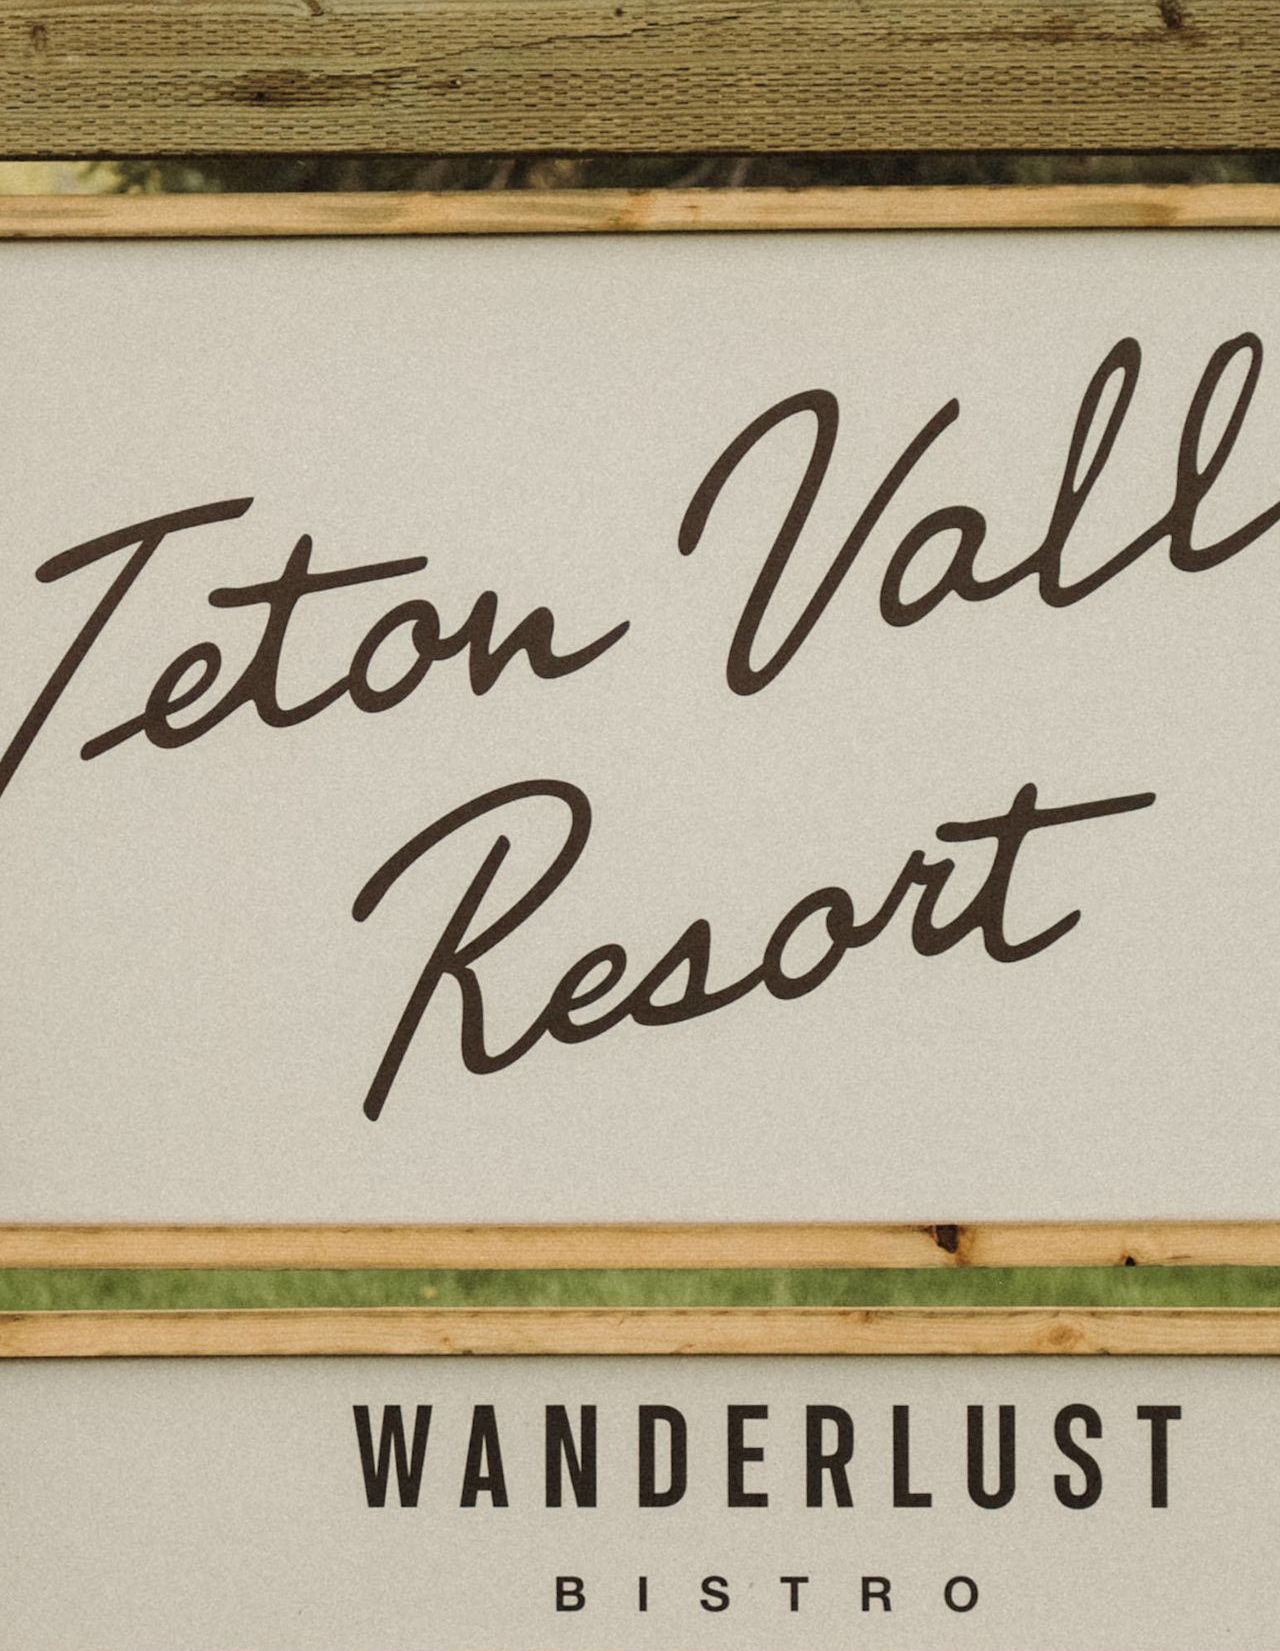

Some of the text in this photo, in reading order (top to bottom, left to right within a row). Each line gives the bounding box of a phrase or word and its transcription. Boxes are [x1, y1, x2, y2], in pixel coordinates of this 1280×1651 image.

[352, 779, 1156, 1121] Resort
[353, 1403, 1182, 1510] WANDERLUST
[556, 1575, 978, 1613] BISTRO
